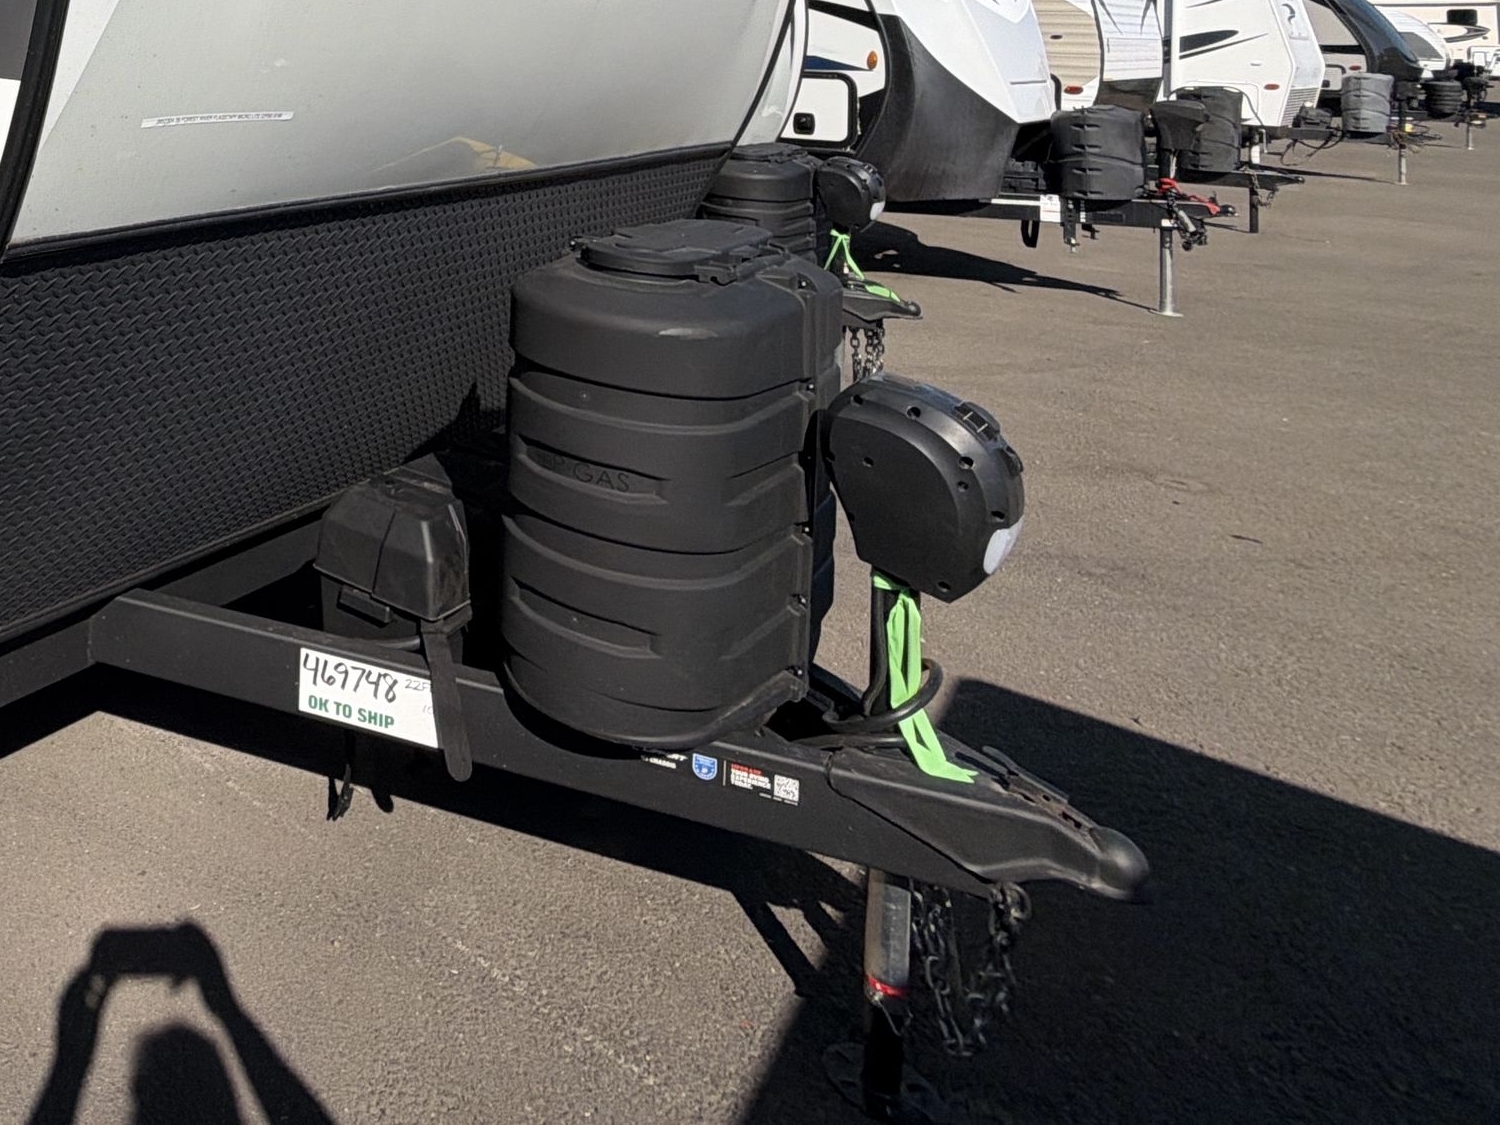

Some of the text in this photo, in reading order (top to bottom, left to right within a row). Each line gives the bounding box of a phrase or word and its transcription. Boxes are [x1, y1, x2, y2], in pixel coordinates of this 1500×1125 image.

[573, 461, 630, 492] GAS
[302, 652, 399, 704] 469748
[308, 694, 395, 728] OK TO SHIP
